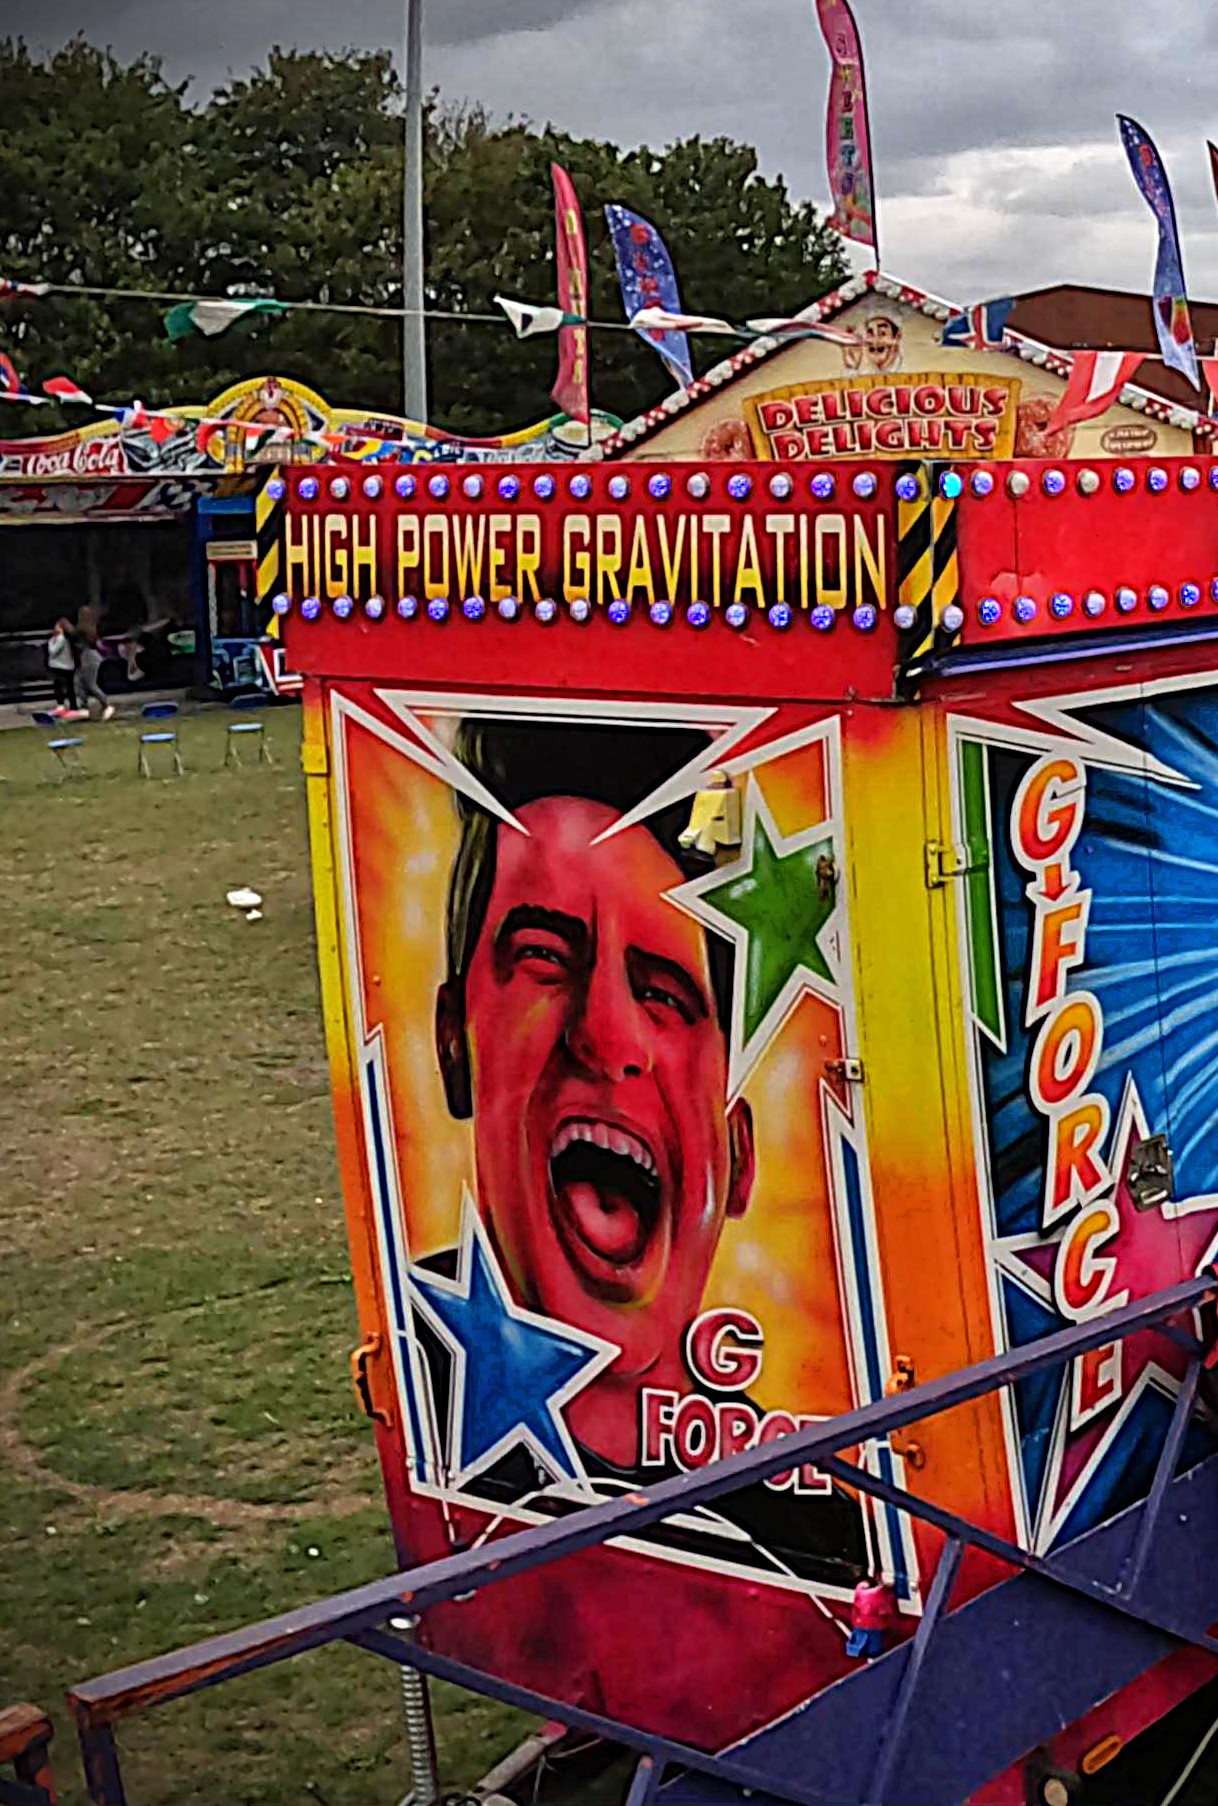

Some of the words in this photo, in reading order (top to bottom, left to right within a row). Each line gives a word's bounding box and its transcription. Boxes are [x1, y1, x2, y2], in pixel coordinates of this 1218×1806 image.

[758, 385, 1008, 433] DELICIOUS
[771, 419, 999, 461] DELIGHTS
[285, 513, 377, 599] HIGH
[397, 513, 541, 602] POWER
[563, 513, 887, 611] GRAVITATION
[686, 1307, 764, 1392] G
[641, 1387, 835, 1496] FORCE
